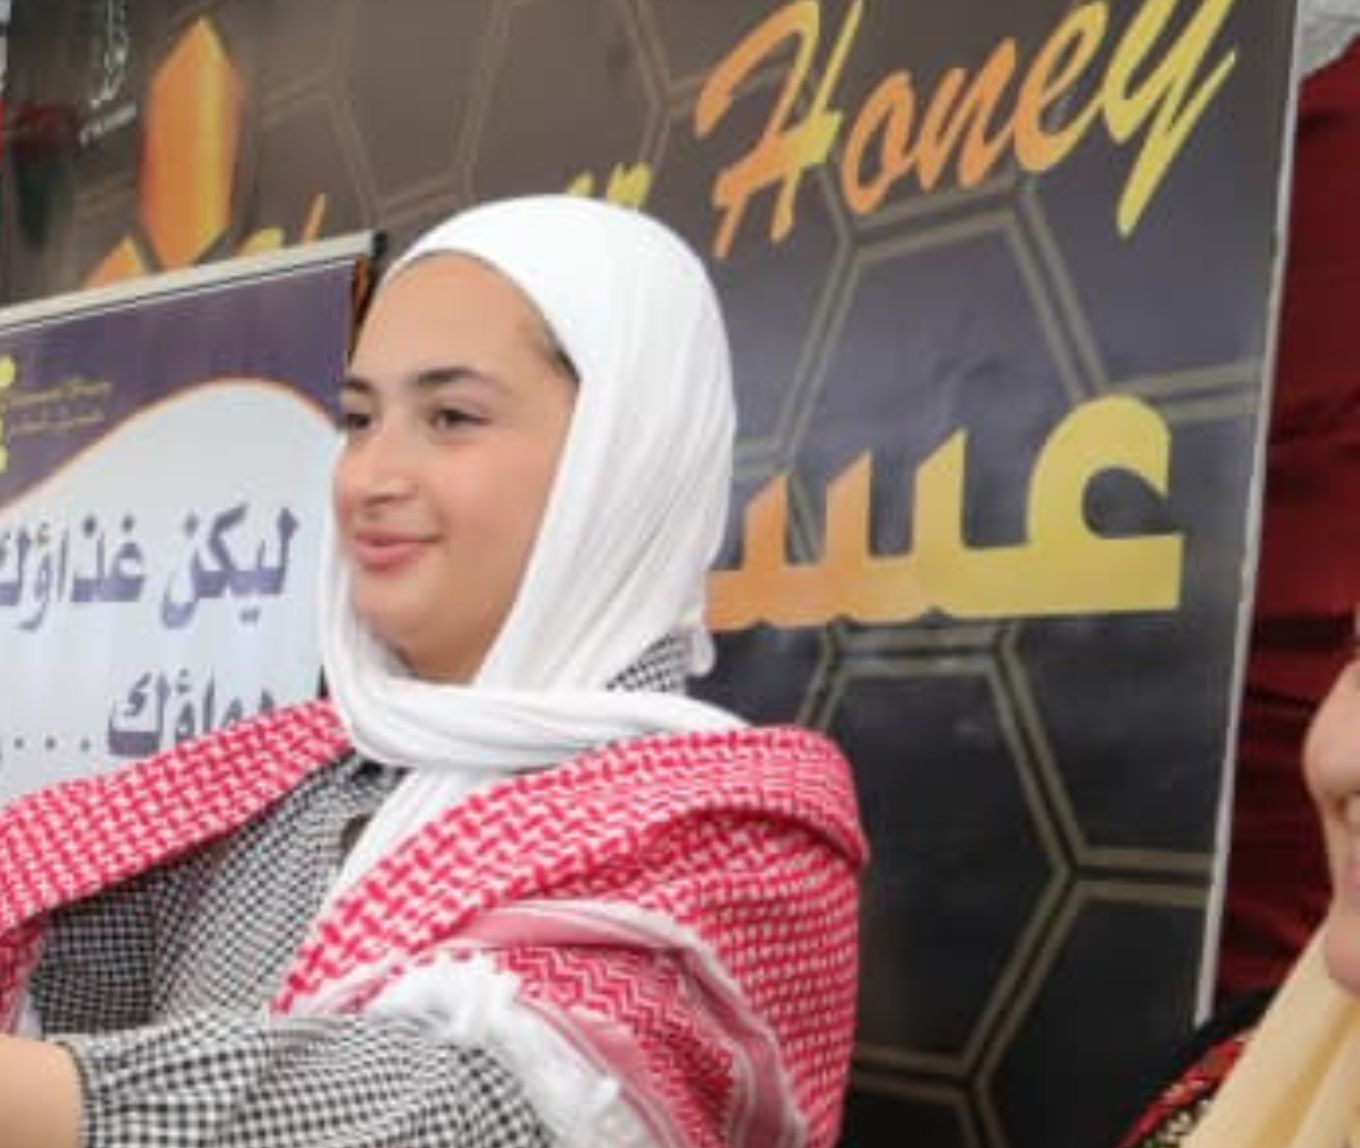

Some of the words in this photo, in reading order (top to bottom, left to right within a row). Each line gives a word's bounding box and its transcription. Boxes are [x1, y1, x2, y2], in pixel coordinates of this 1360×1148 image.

[694, 0, 1235, 258] Honey
[161, 503, 298, 629] ليكن
[705, 393, 1184, 633] عس
